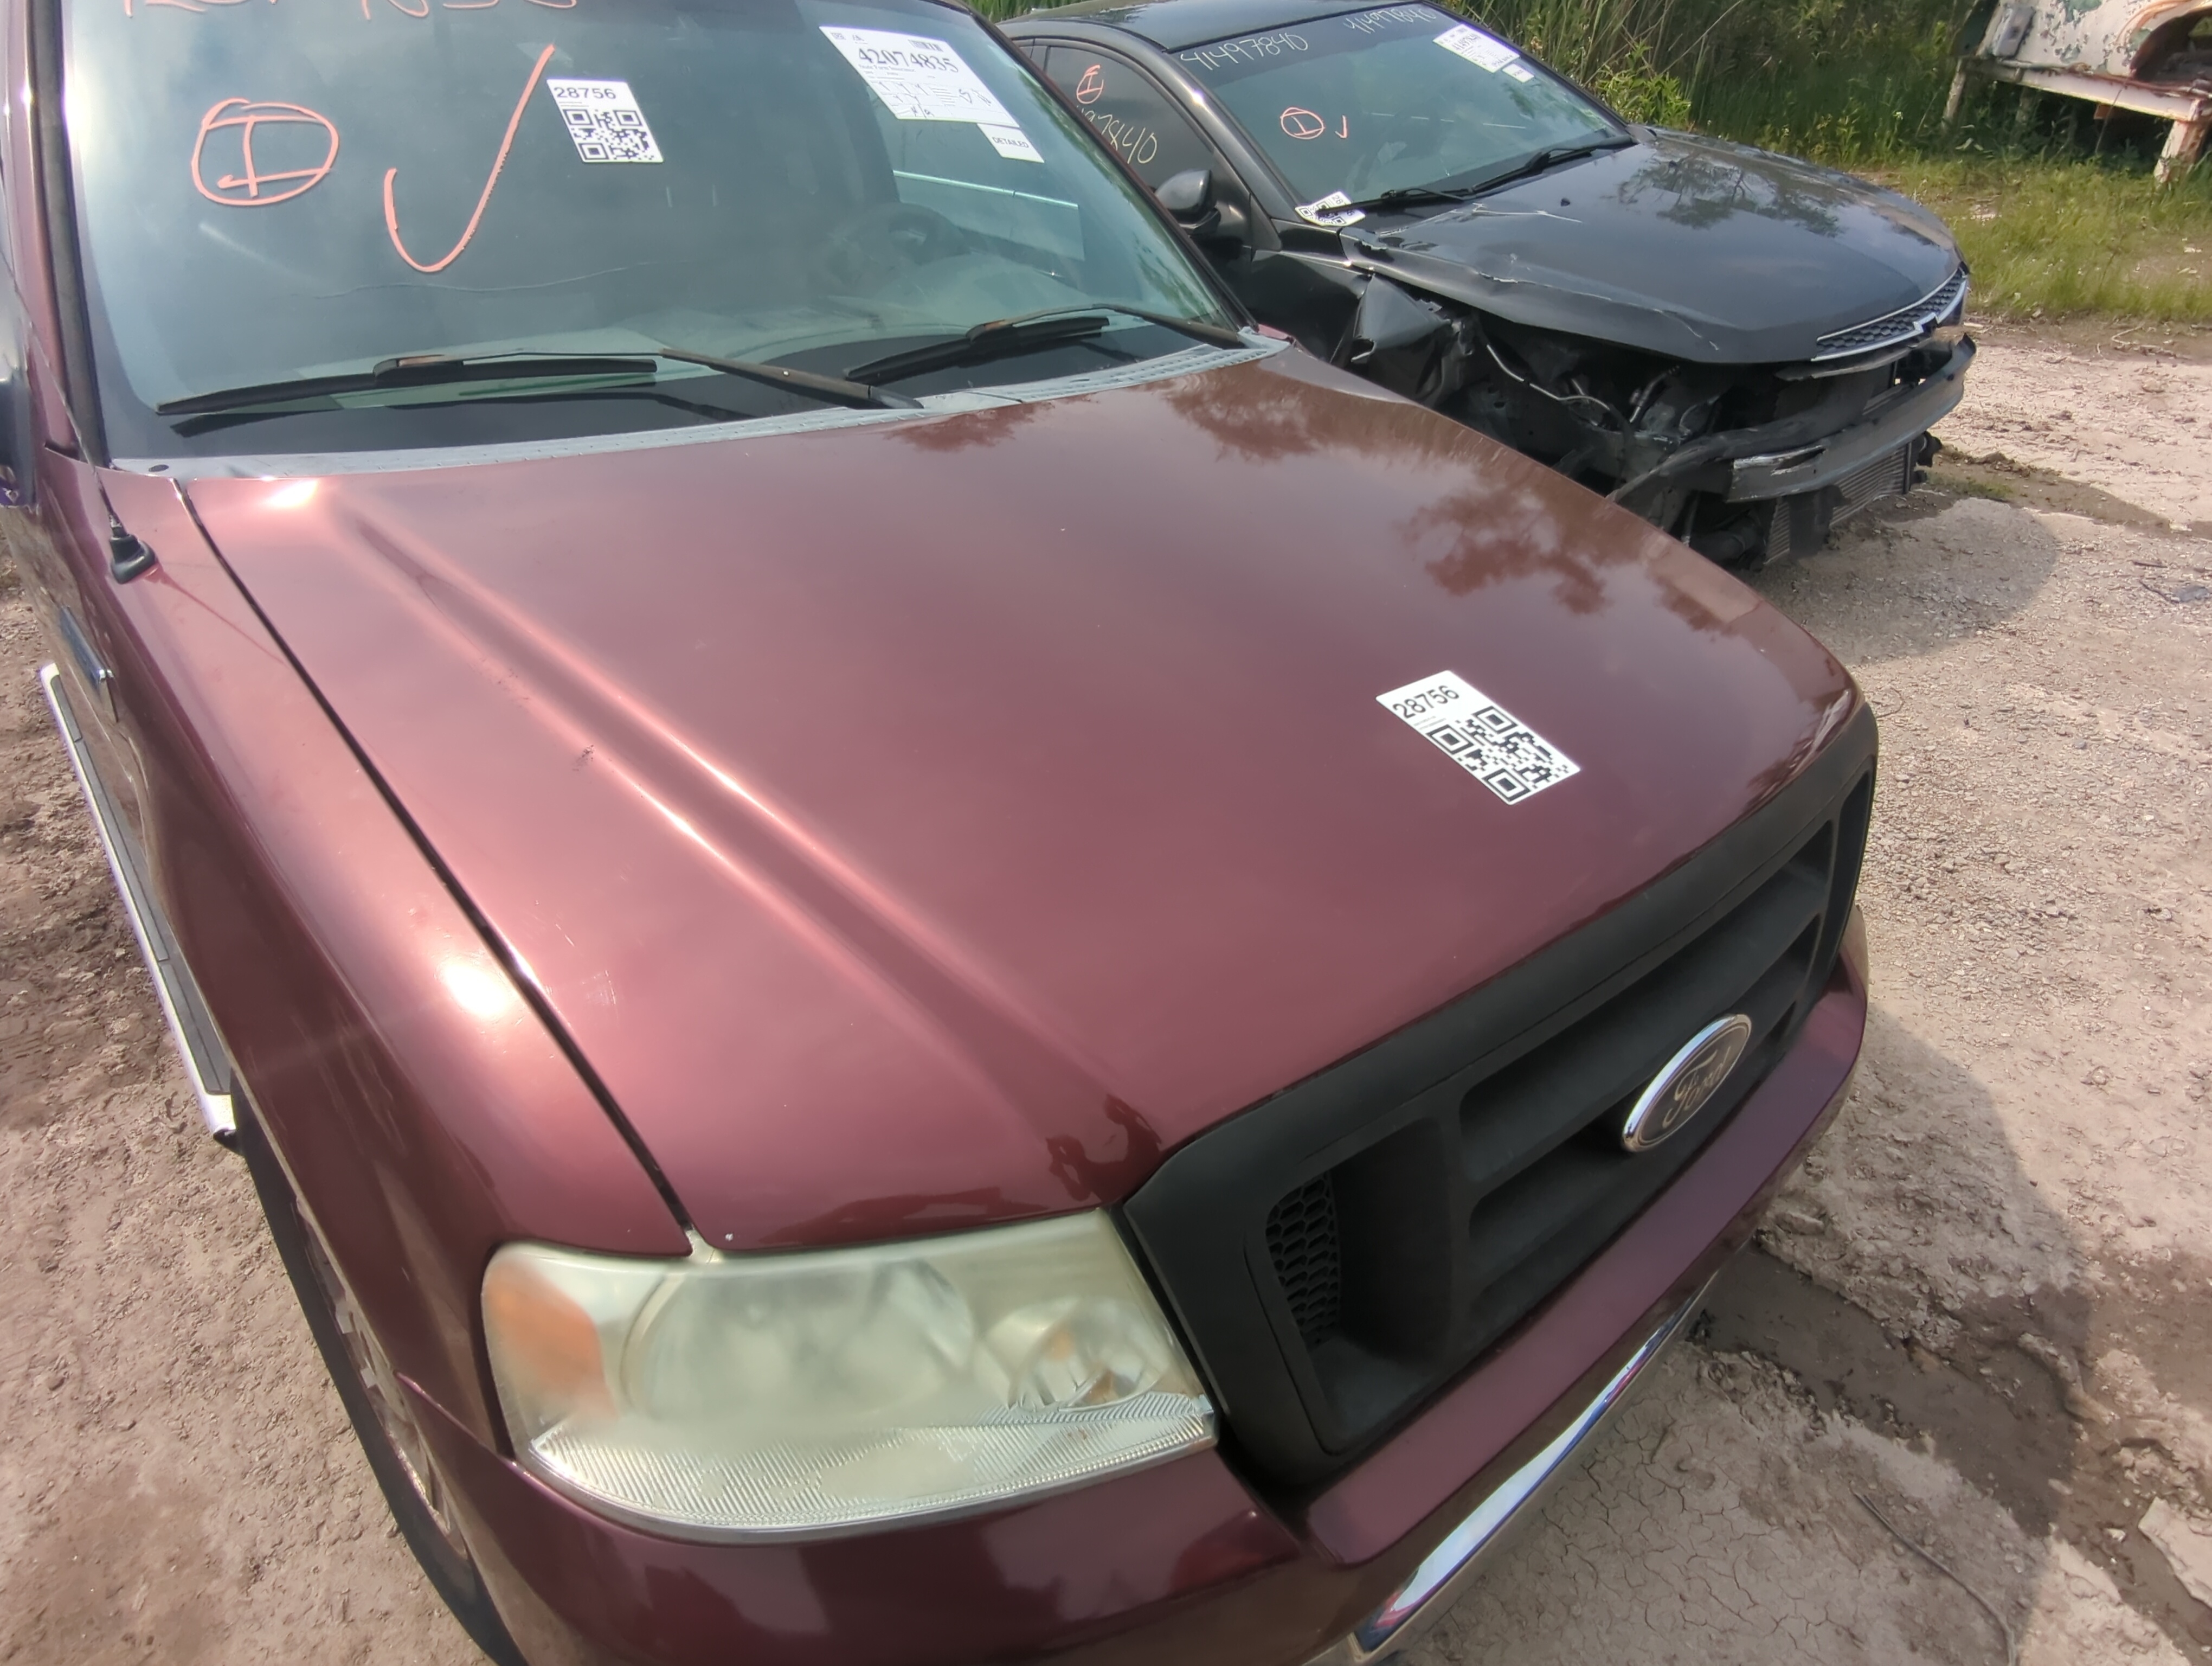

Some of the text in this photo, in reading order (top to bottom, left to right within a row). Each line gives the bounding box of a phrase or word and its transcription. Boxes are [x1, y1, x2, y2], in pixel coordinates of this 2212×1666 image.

[859, 48, 959, 73] 42074835
[1180, 33, 1308, 71] 41497840
[554, 87, 616, 99] 28756
[1392, 685, 1459, 719] 28756
